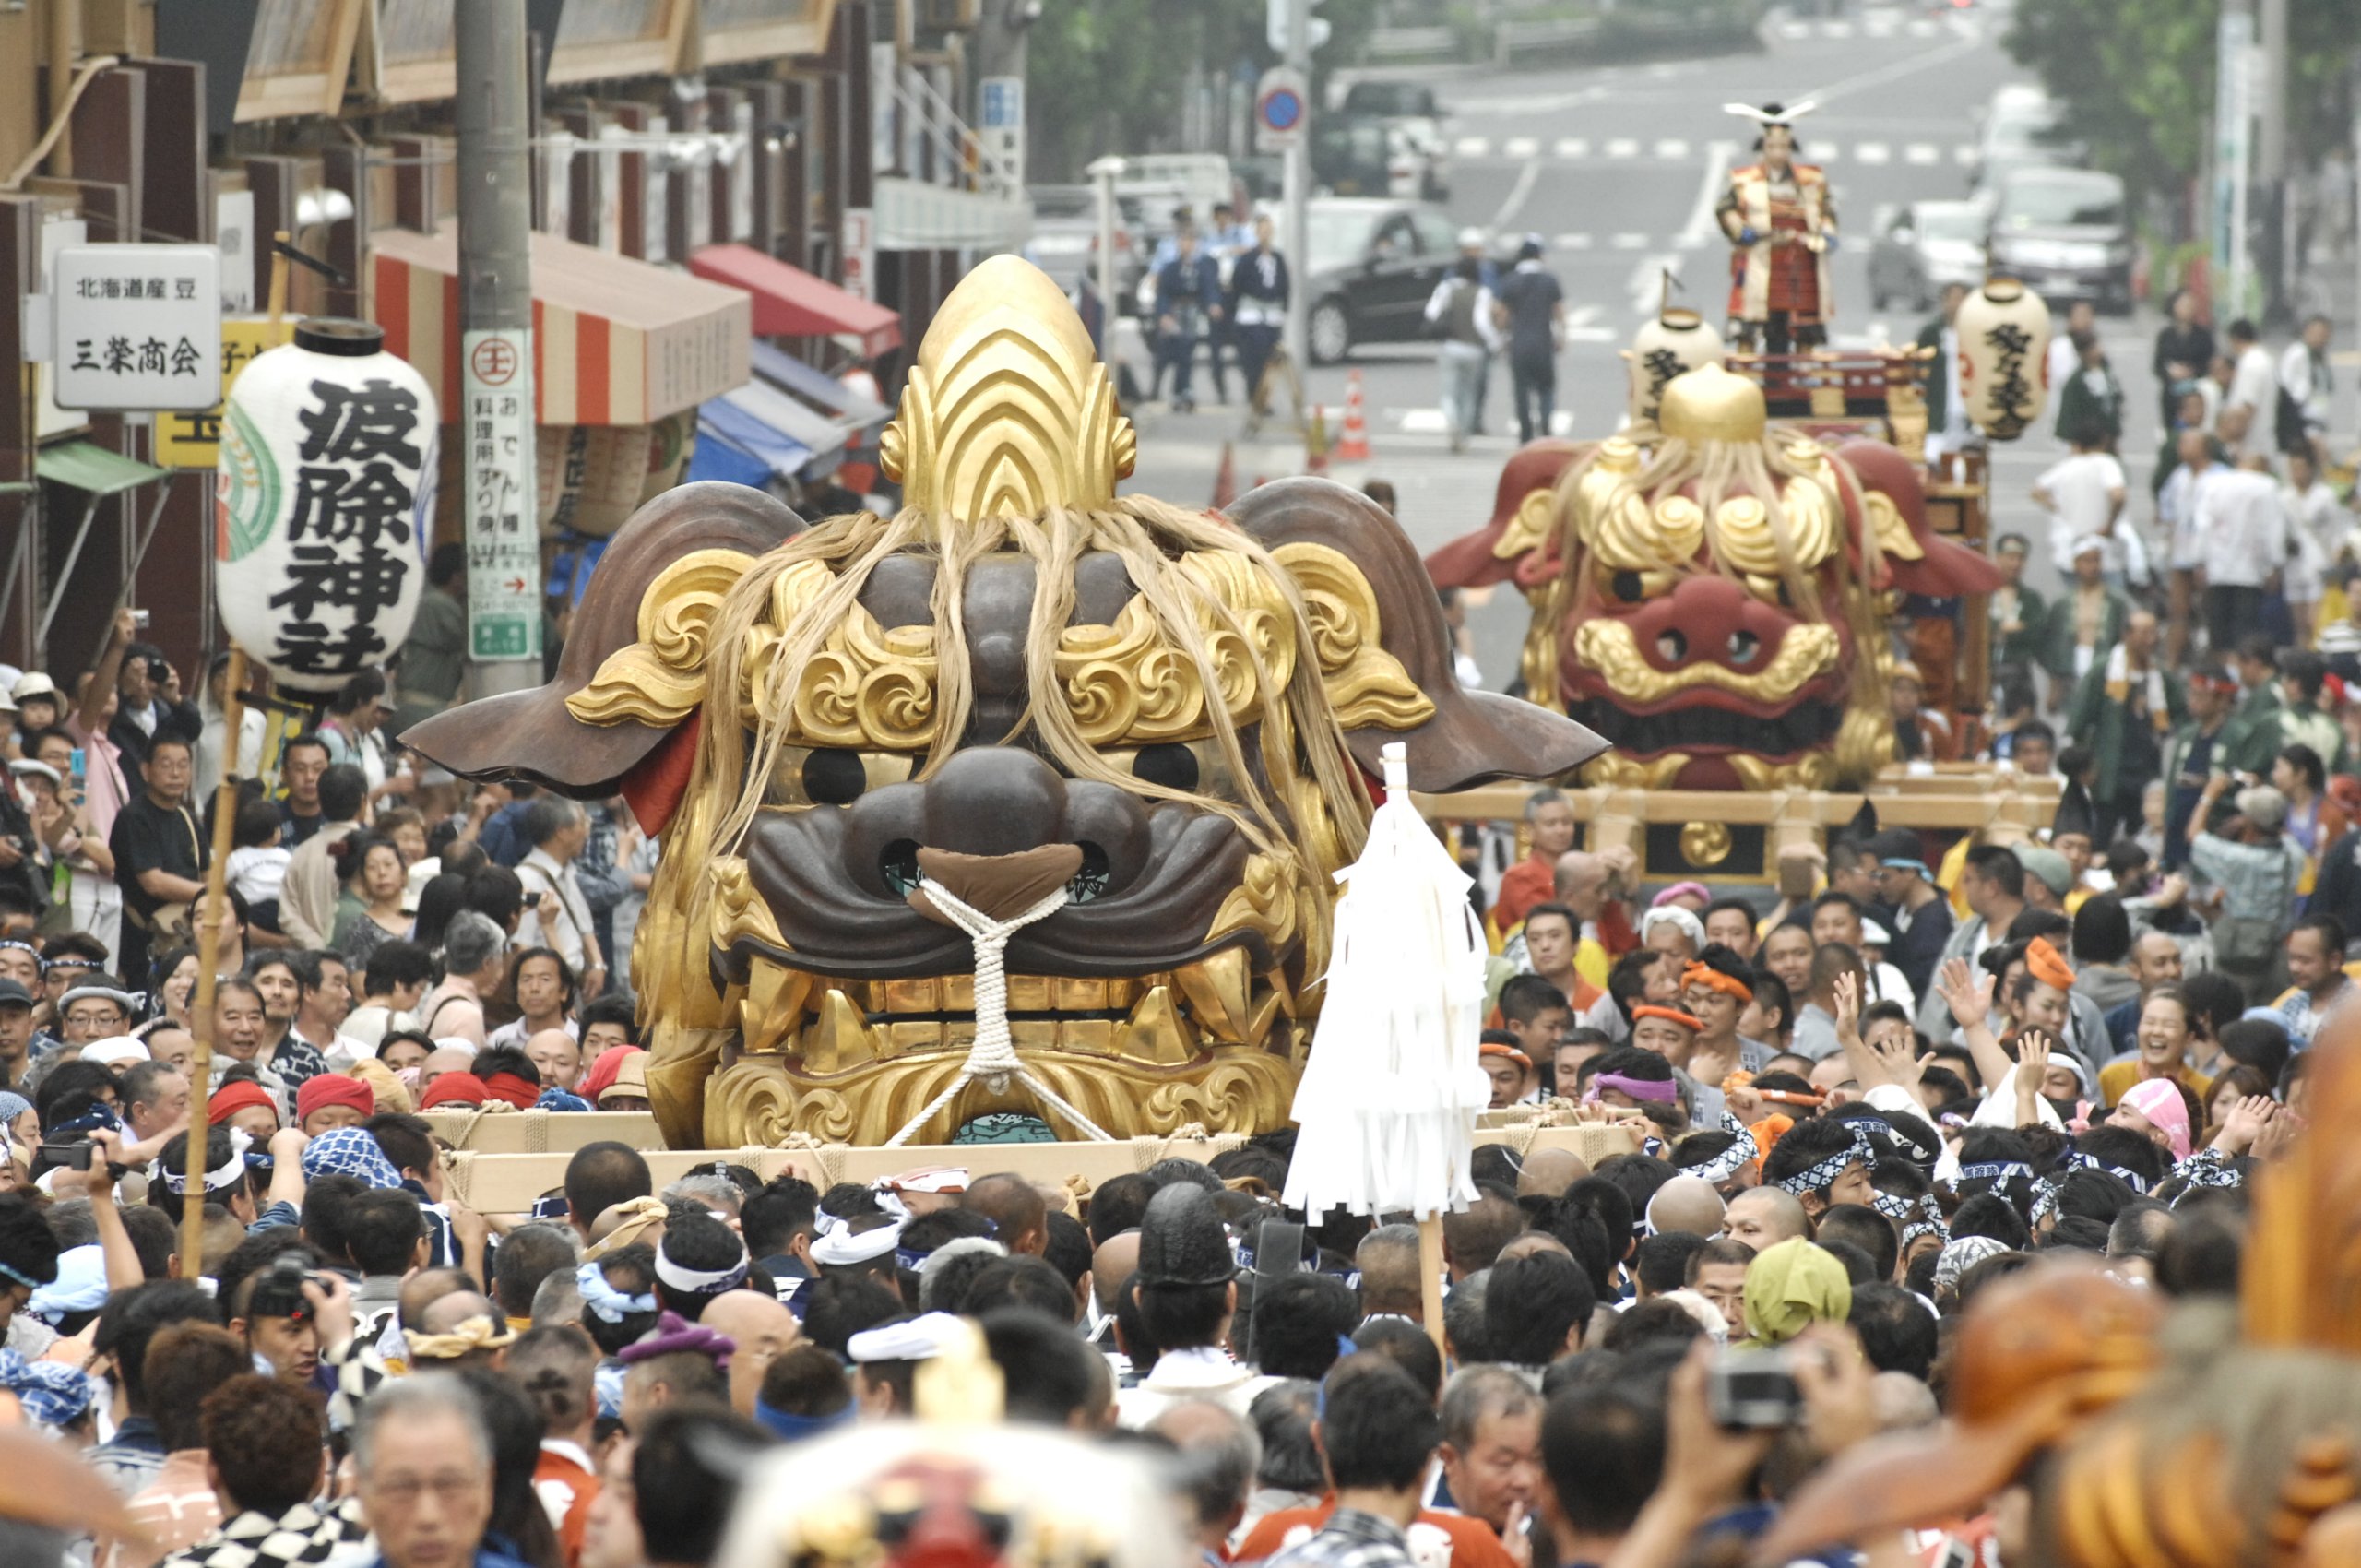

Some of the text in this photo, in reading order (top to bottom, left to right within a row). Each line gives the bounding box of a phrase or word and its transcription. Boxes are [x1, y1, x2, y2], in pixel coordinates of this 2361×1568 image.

[76, 278, 197, 300] 北海道産 豆
[71, 335, 201, 377] 三榮商会
[268, 379, 421, 674] 波除神社
